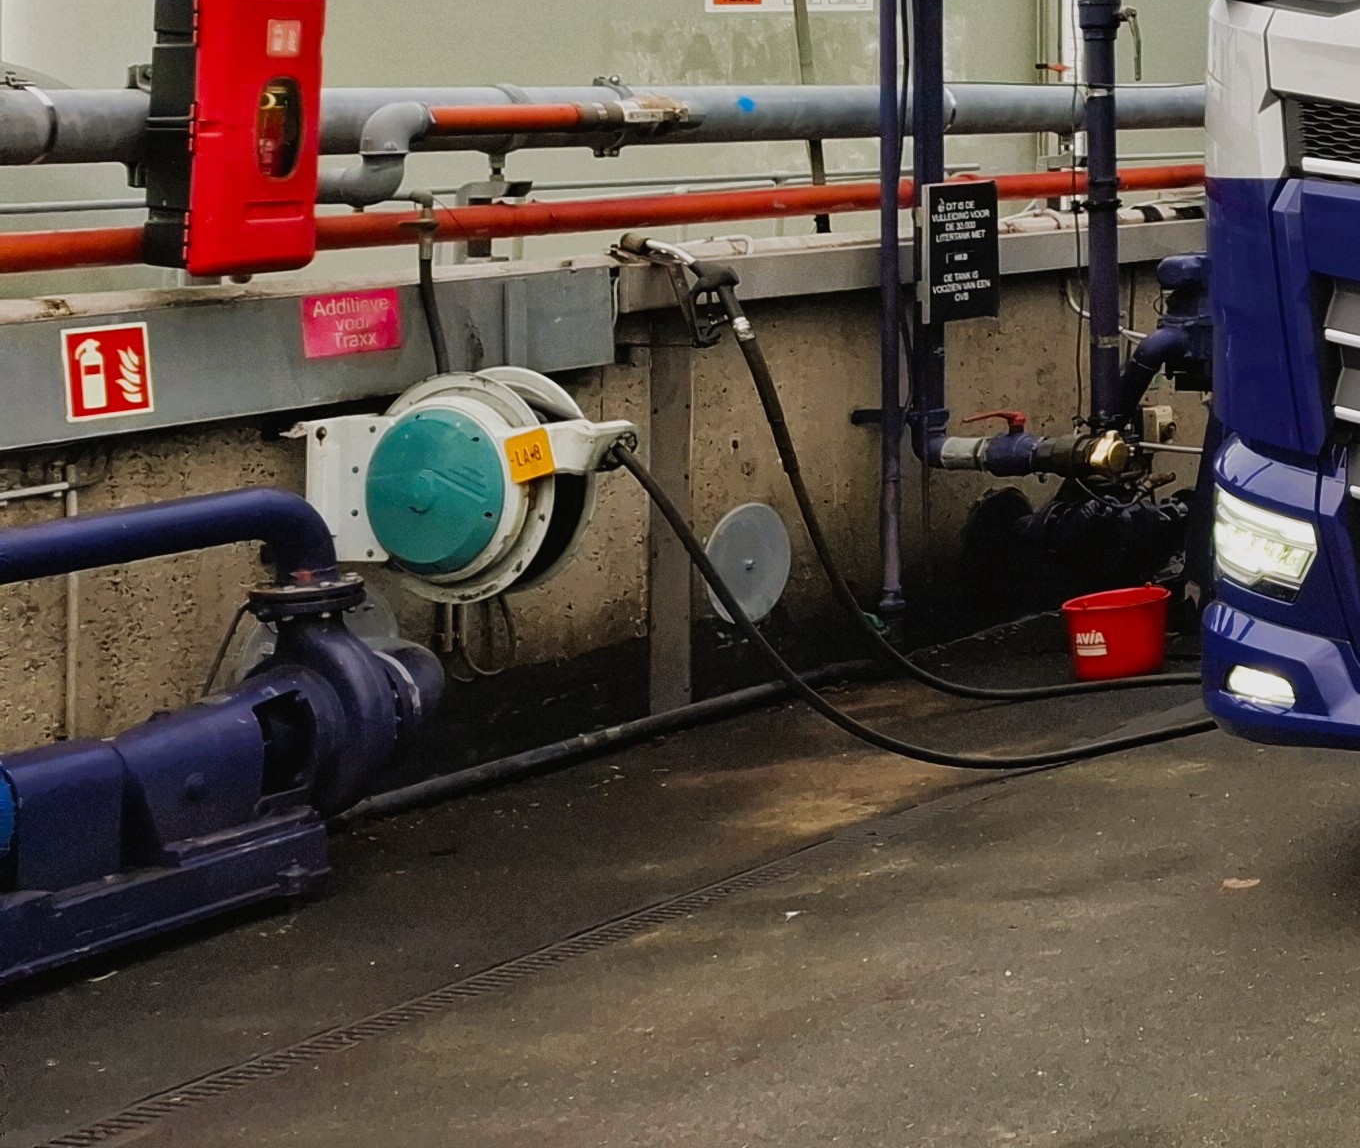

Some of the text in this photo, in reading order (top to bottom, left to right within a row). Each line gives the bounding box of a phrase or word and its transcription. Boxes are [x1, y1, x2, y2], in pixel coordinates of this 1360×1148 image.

[965, 200, 975, 209] DE
[970, 209, 990, 218] VOOR
[945, 222, 956, 232] DE
[943, 273, 954, 283] DE
[312, 297, 389, 318] Additieve
[333, 331, 378, 349] Traxx
